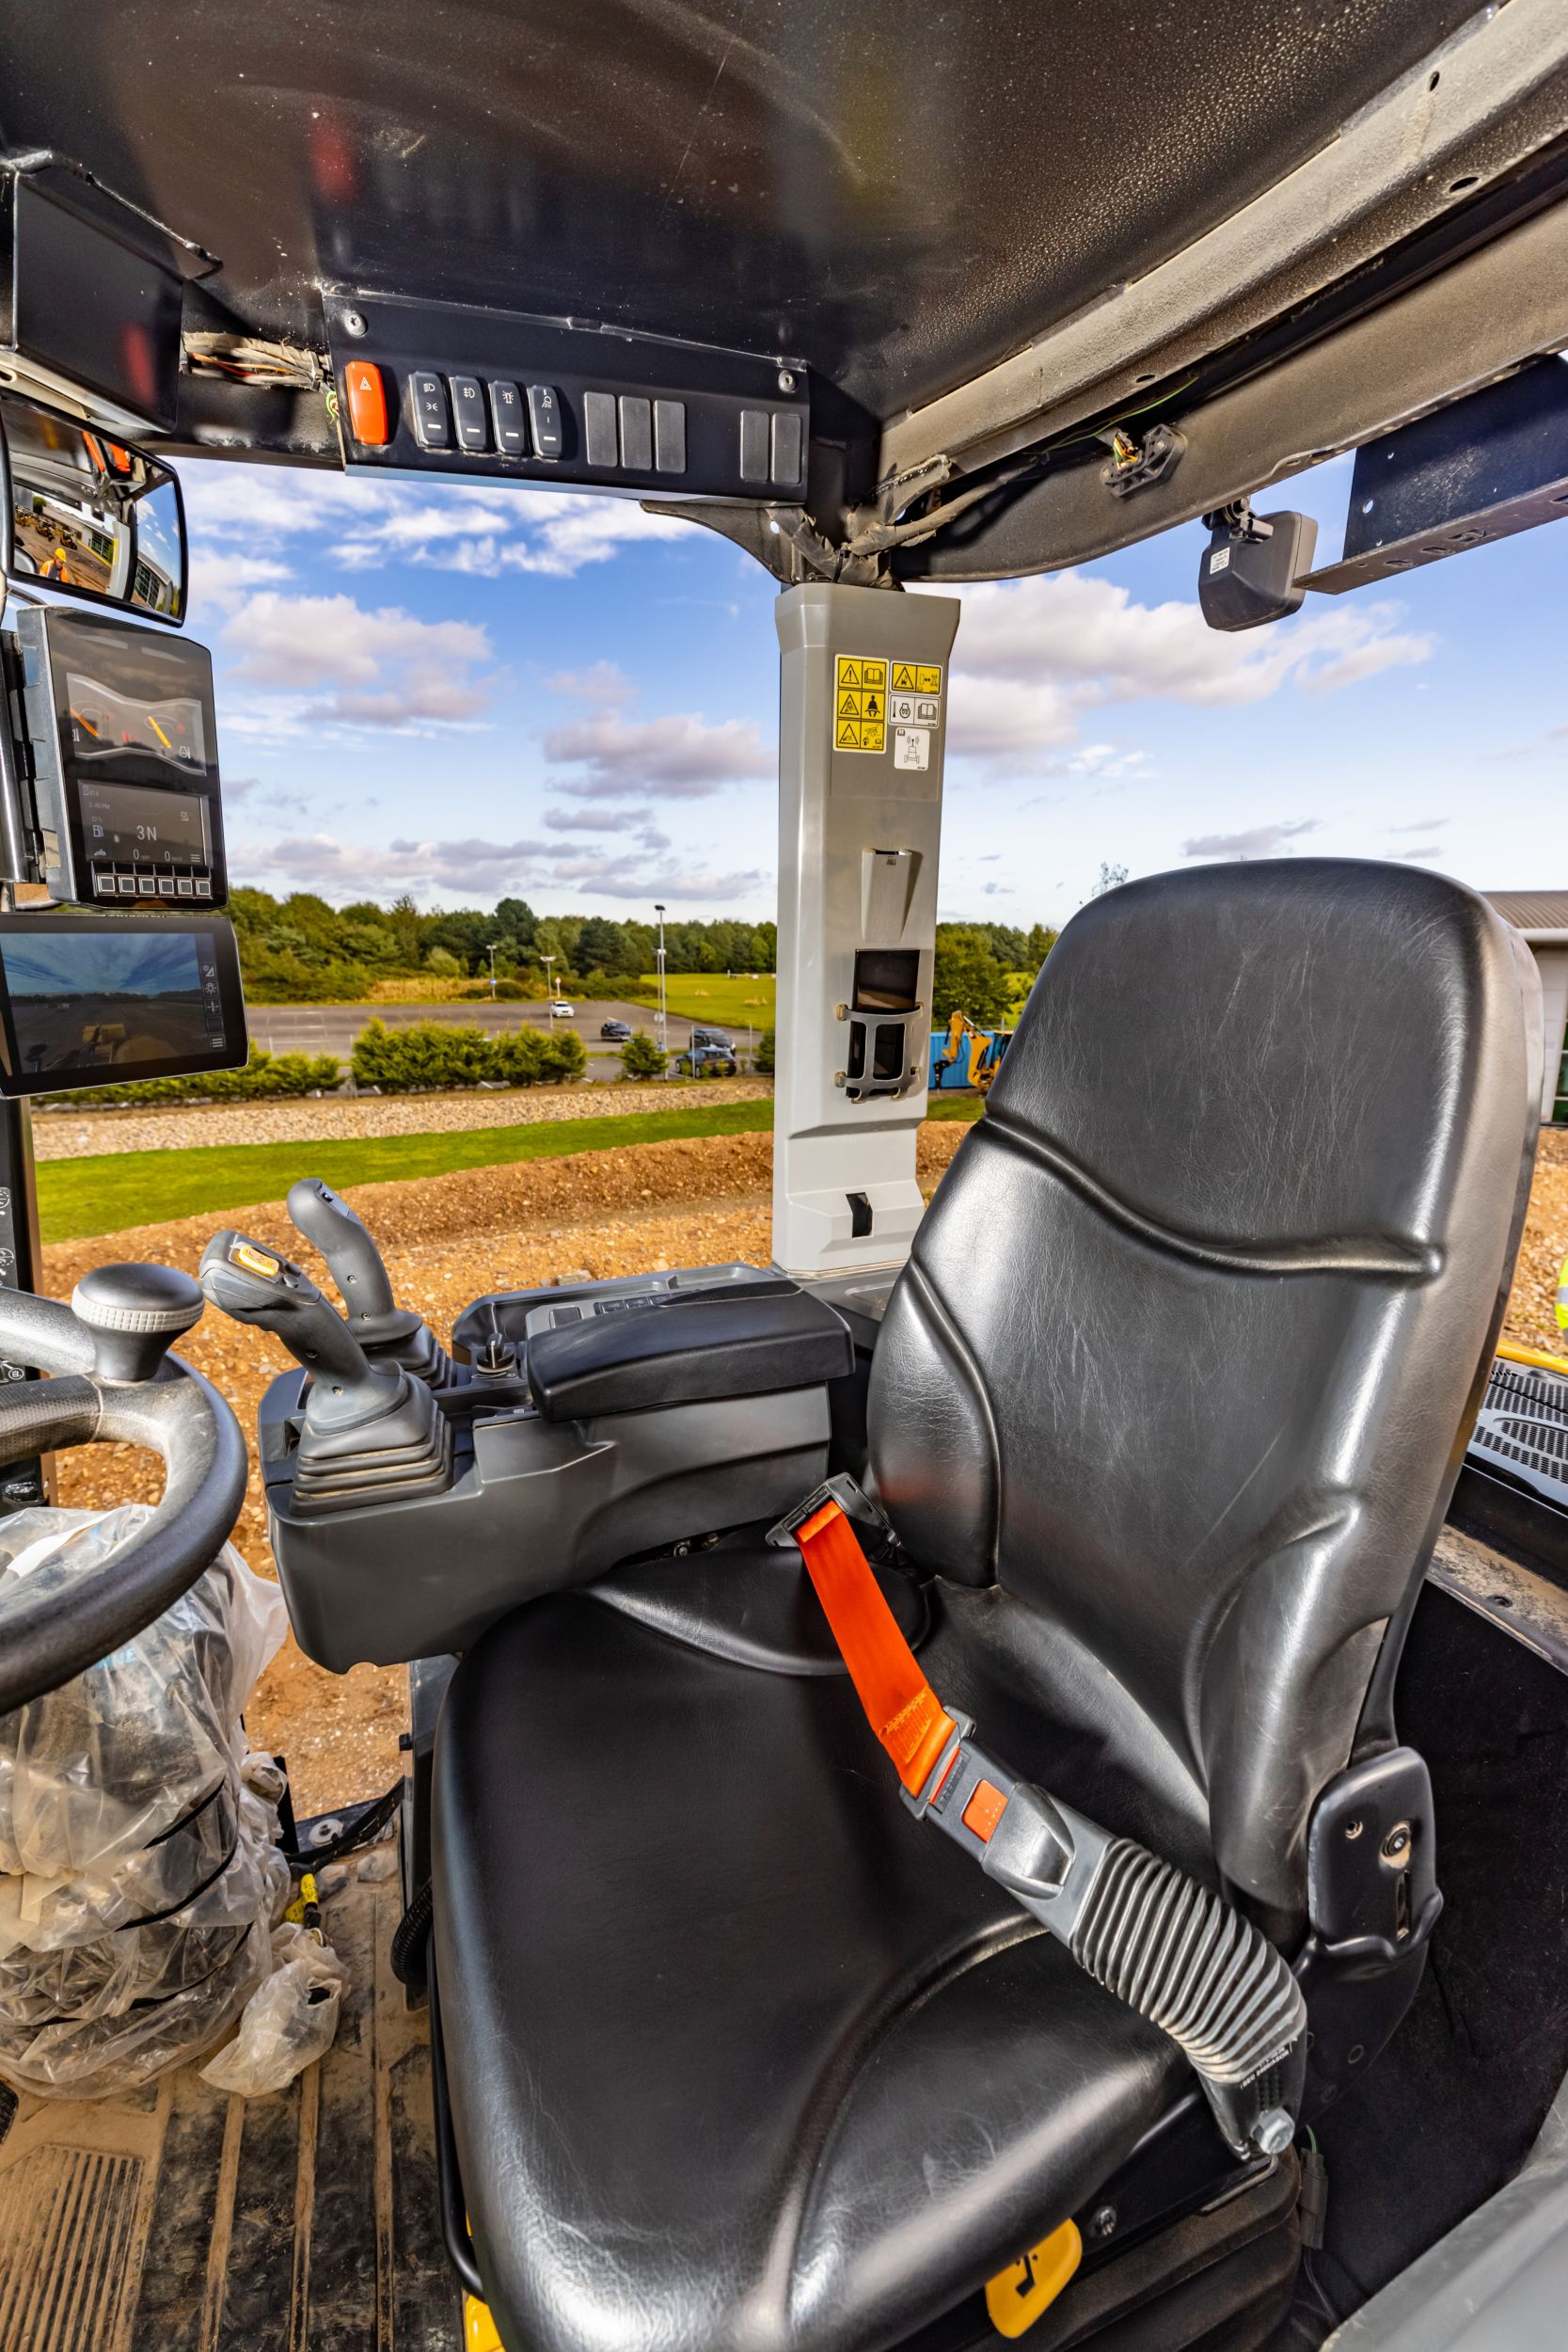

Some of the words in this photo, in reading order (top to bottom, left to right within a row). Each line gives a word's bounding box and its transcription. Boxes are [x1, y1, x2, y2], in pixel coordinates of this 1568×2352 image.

[136, 825, 157, 841] 3N
[133, 849, 139, 860] 0
[164, 851, 170, 861] 0
